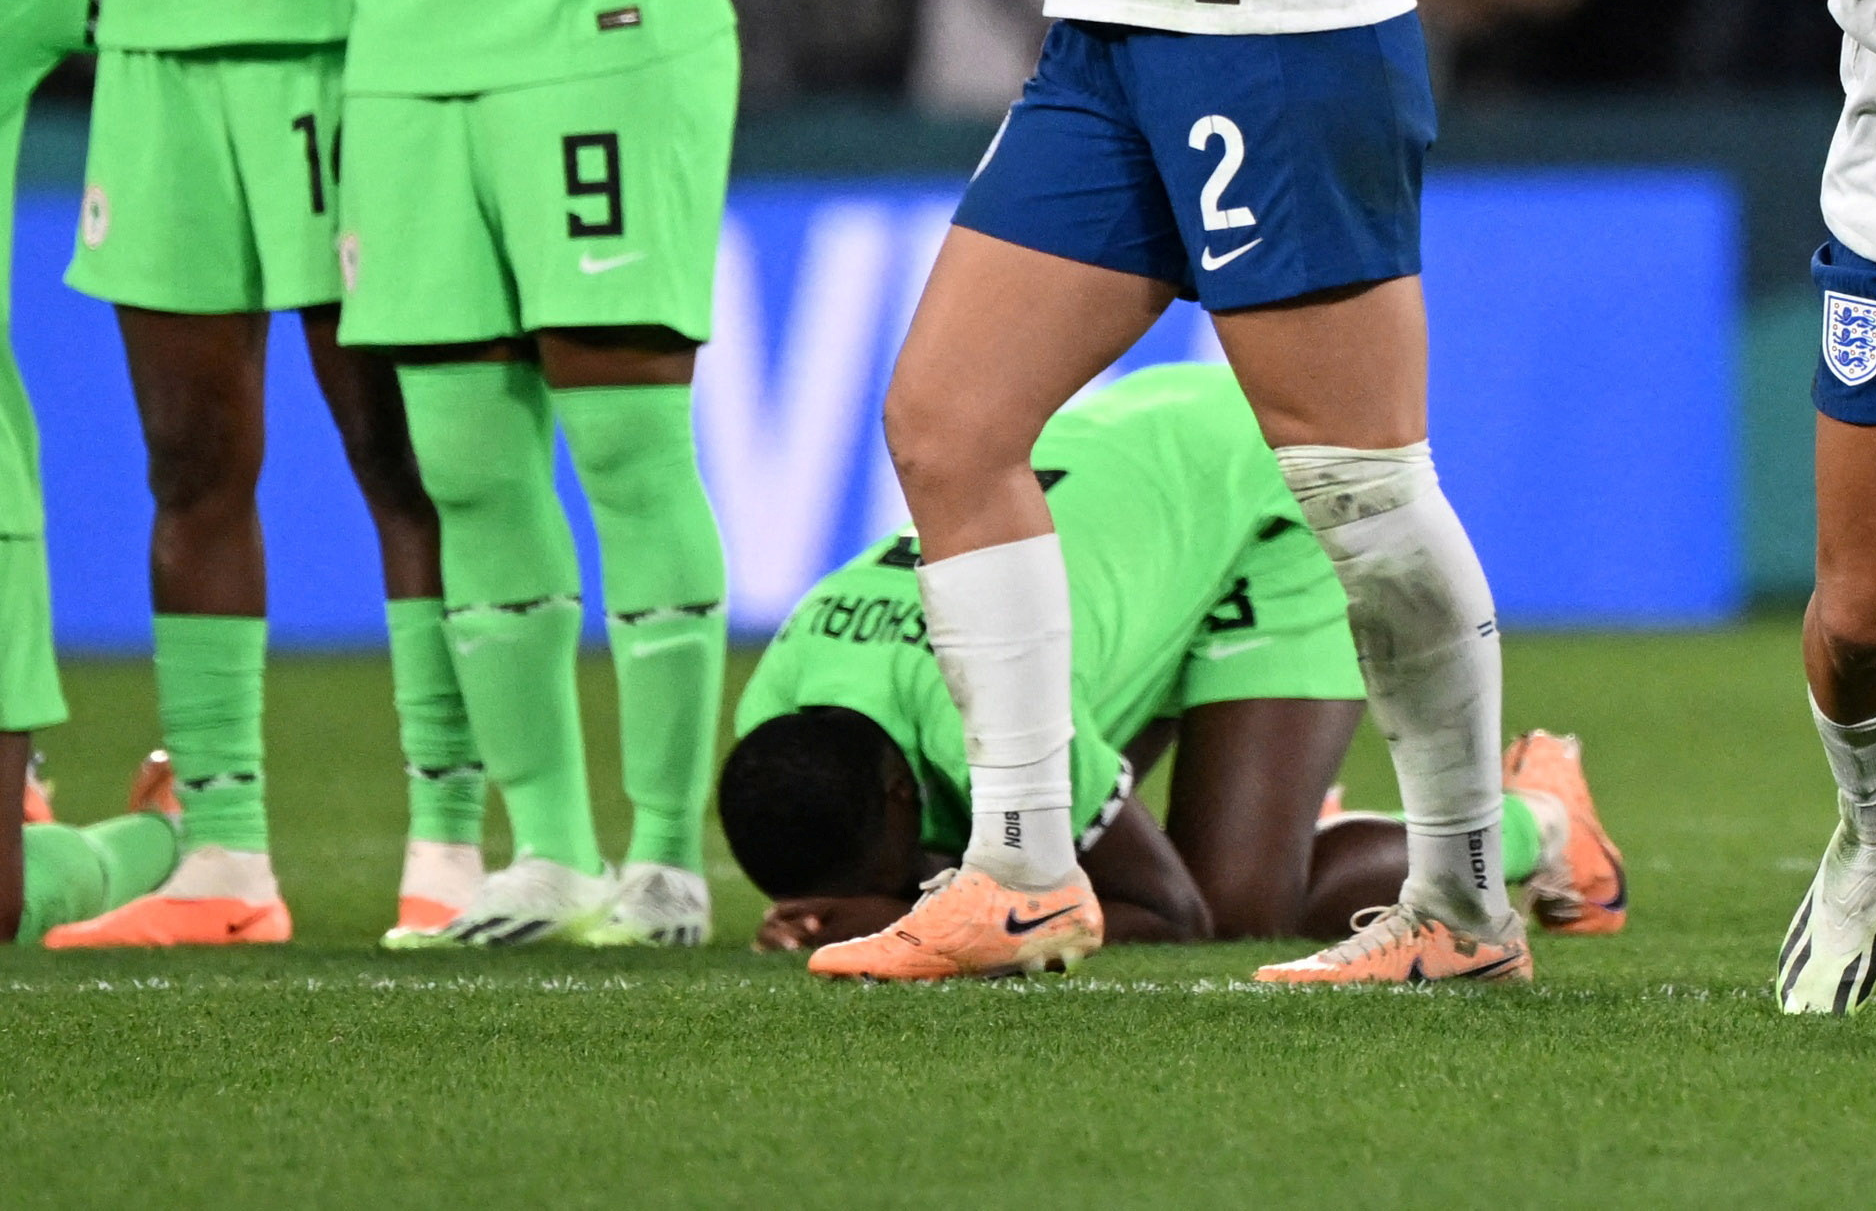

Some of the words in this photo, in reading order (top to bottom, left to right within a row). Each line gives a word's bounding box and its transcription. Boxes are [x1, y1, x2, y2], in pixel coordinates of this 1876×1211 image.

[291, 112, 342, 215] 1
[562, 131, 624, 239] 9
[1187, 114, 1257, 231] 2
